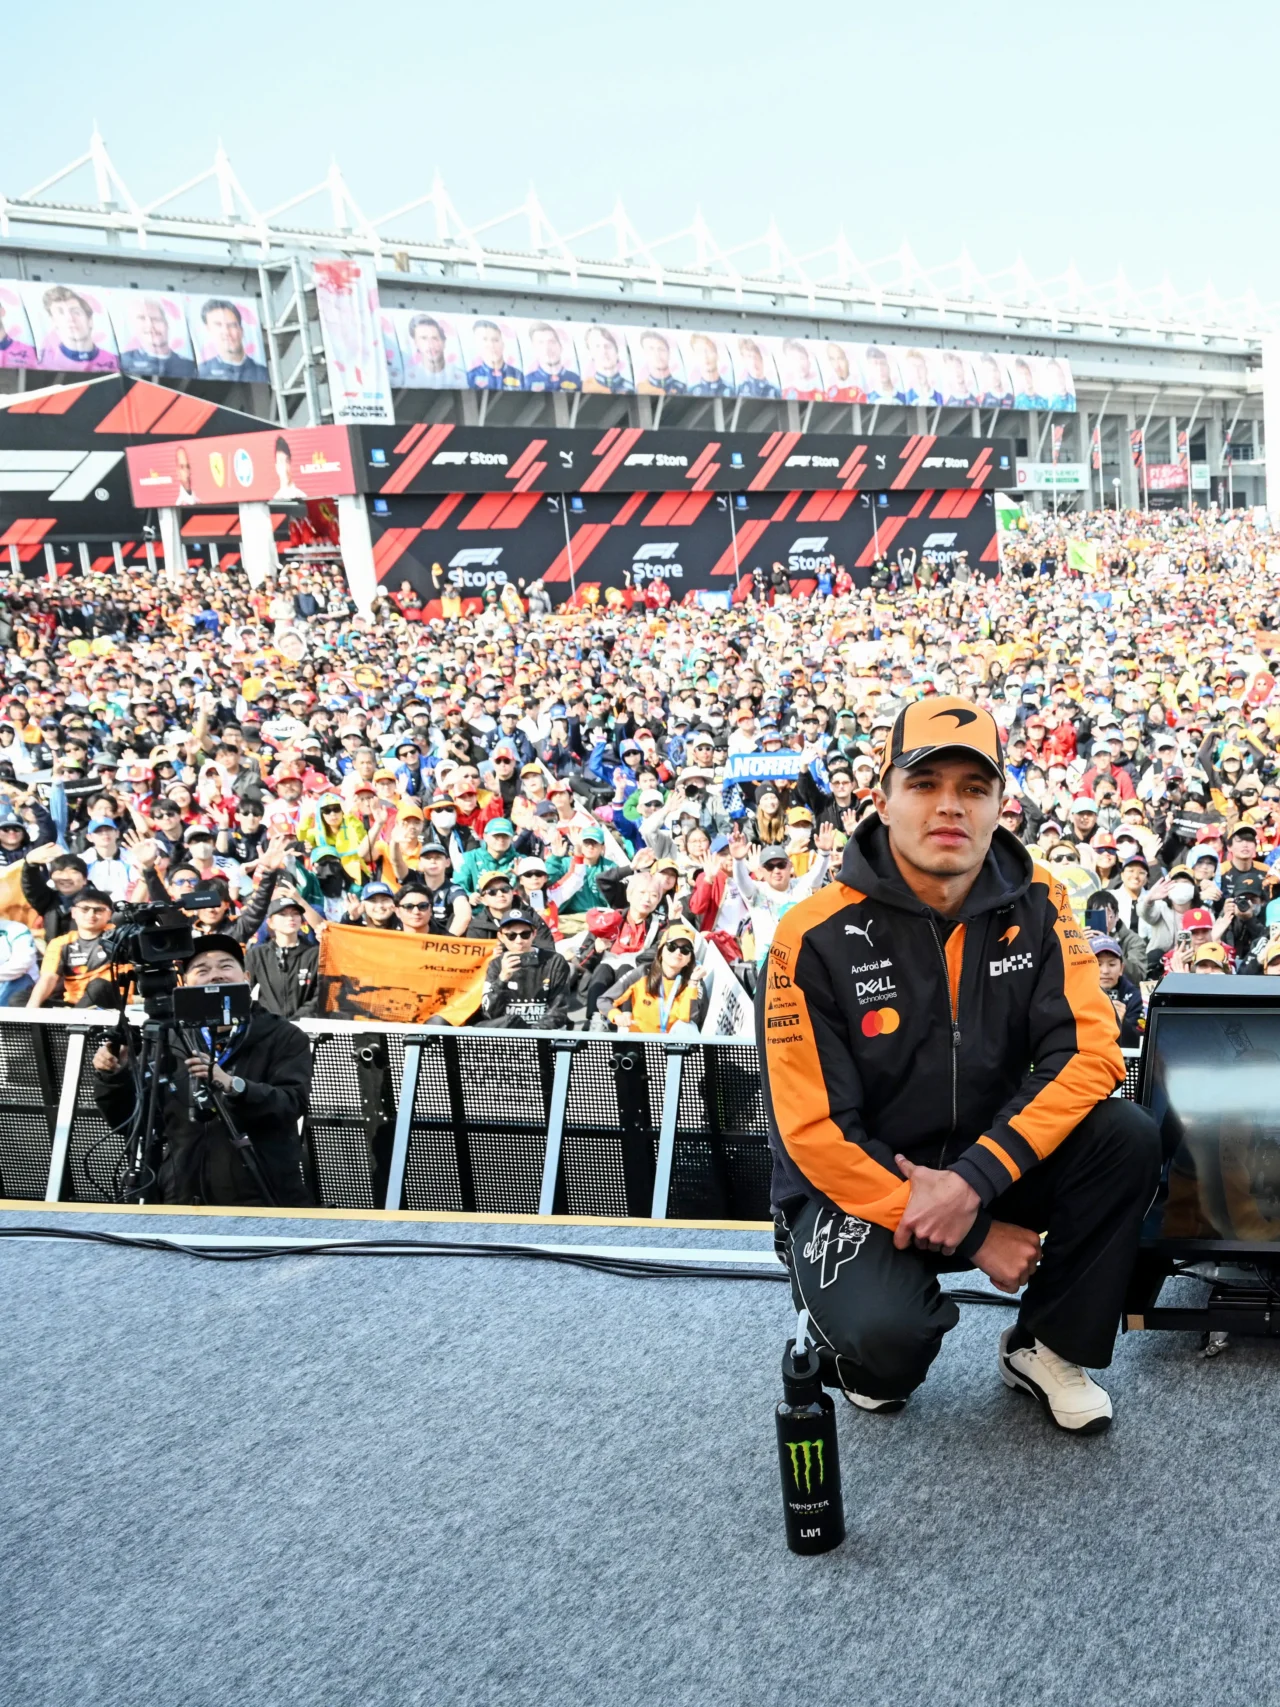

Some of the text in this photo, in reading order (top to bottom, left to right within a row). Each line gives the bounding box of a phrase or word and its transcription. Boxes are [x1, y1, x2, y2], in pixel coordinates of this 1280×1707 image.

[469, 451, 508, 466] Store
[655, 453, 688, 467] Store
[812, 455, 839, 468] Store
[945, 456, 969, 469] Store
[632, 562, 684, 580] Store
[788, 555, 832, 572] Store
[447, 569, 508, 588] Store
[734, 755, 802, 777] NORRI
[424, 941, 486, 957] PIASTRI
[420, 964, 476, 974] McLaren
[851, 960, 880, 975] Android
[989, 952, 1034, 977] OKX
[855, 975, 897, 997] DELL
[857, 991, 898, 1006] Technologies
[767, 1013, 800, 1029] PIRELLI
[789, 1499, 830, 1511] MONSTER
[800, 1527, 821, 1538] LN1
